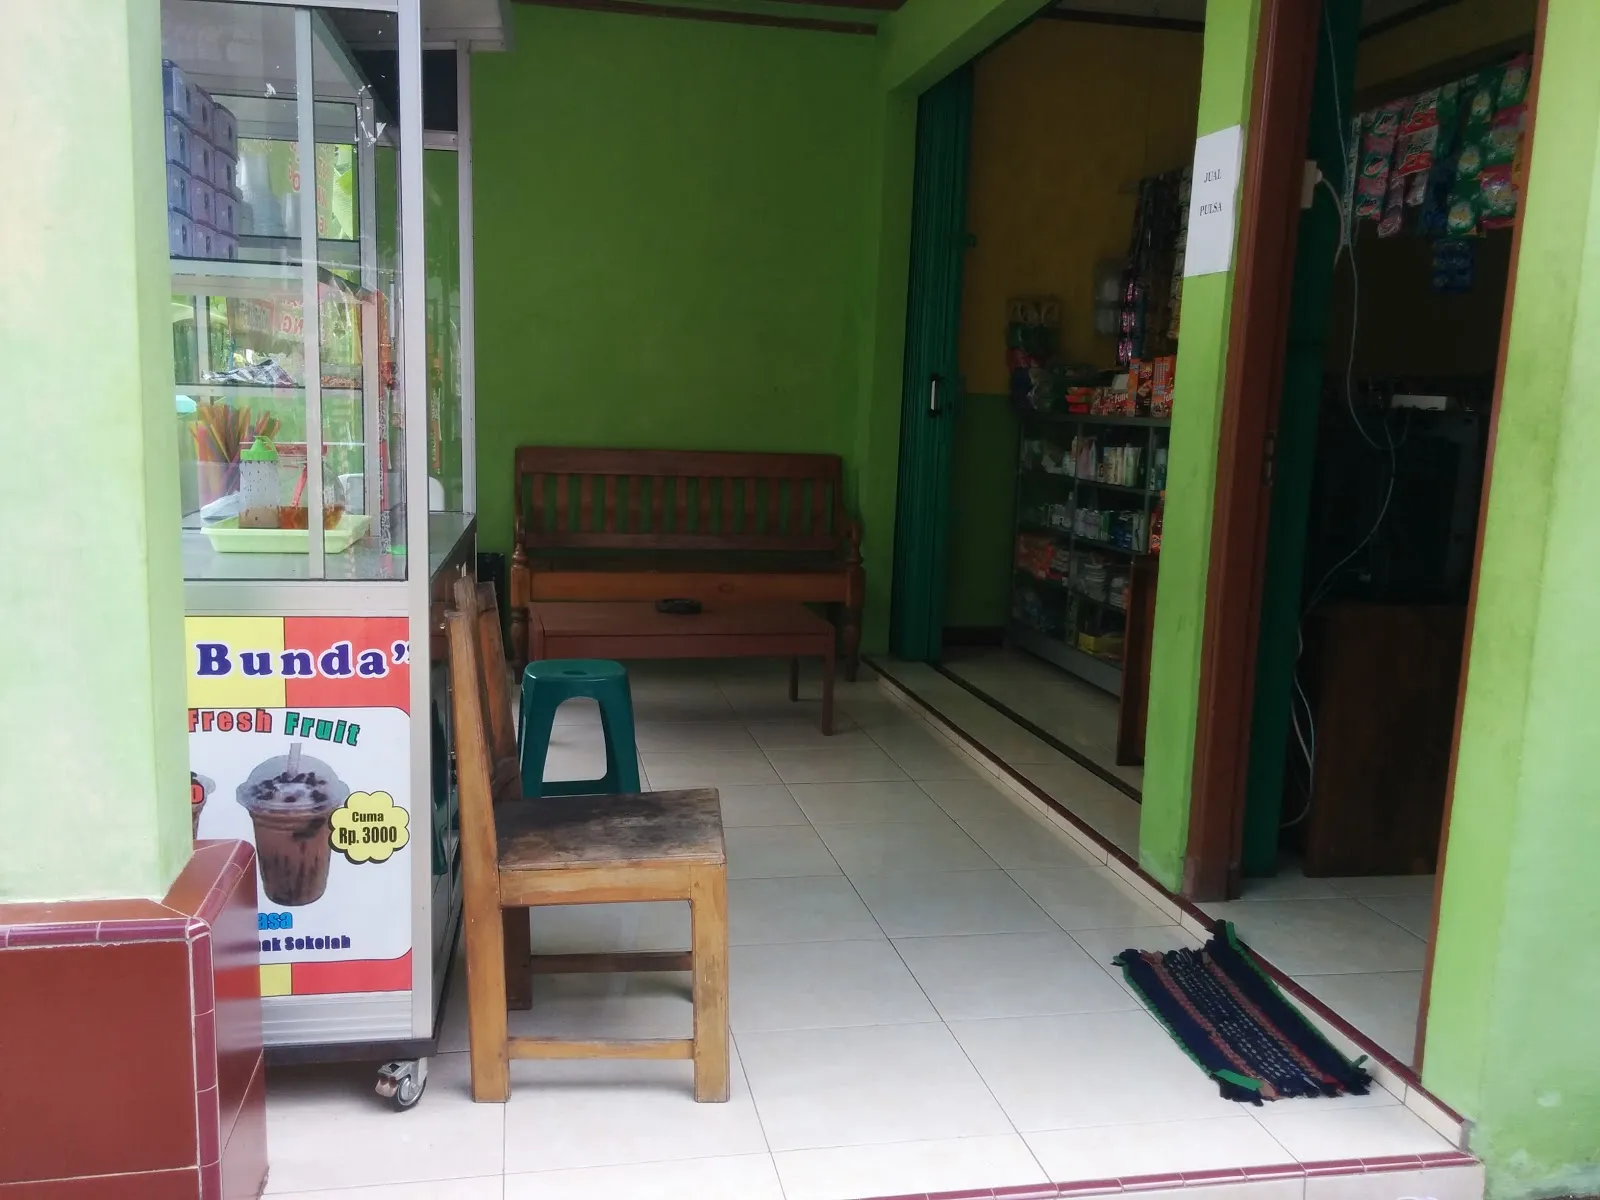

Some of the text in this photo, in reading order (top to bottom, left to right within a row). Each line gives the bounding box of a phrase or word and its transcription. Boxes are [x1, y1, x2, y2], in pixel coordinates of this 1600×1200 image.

[1203, 168, 1222, 183] JUAL
[1199, 201, 1222, 216] PULSA
[188, 708, 361, 746] Fresh Fruit
[351, 811, 385, 823] Cuma
[339, 825, 398, 846] Rp. 3000
[284, 935, 351, 951] Sekolah
